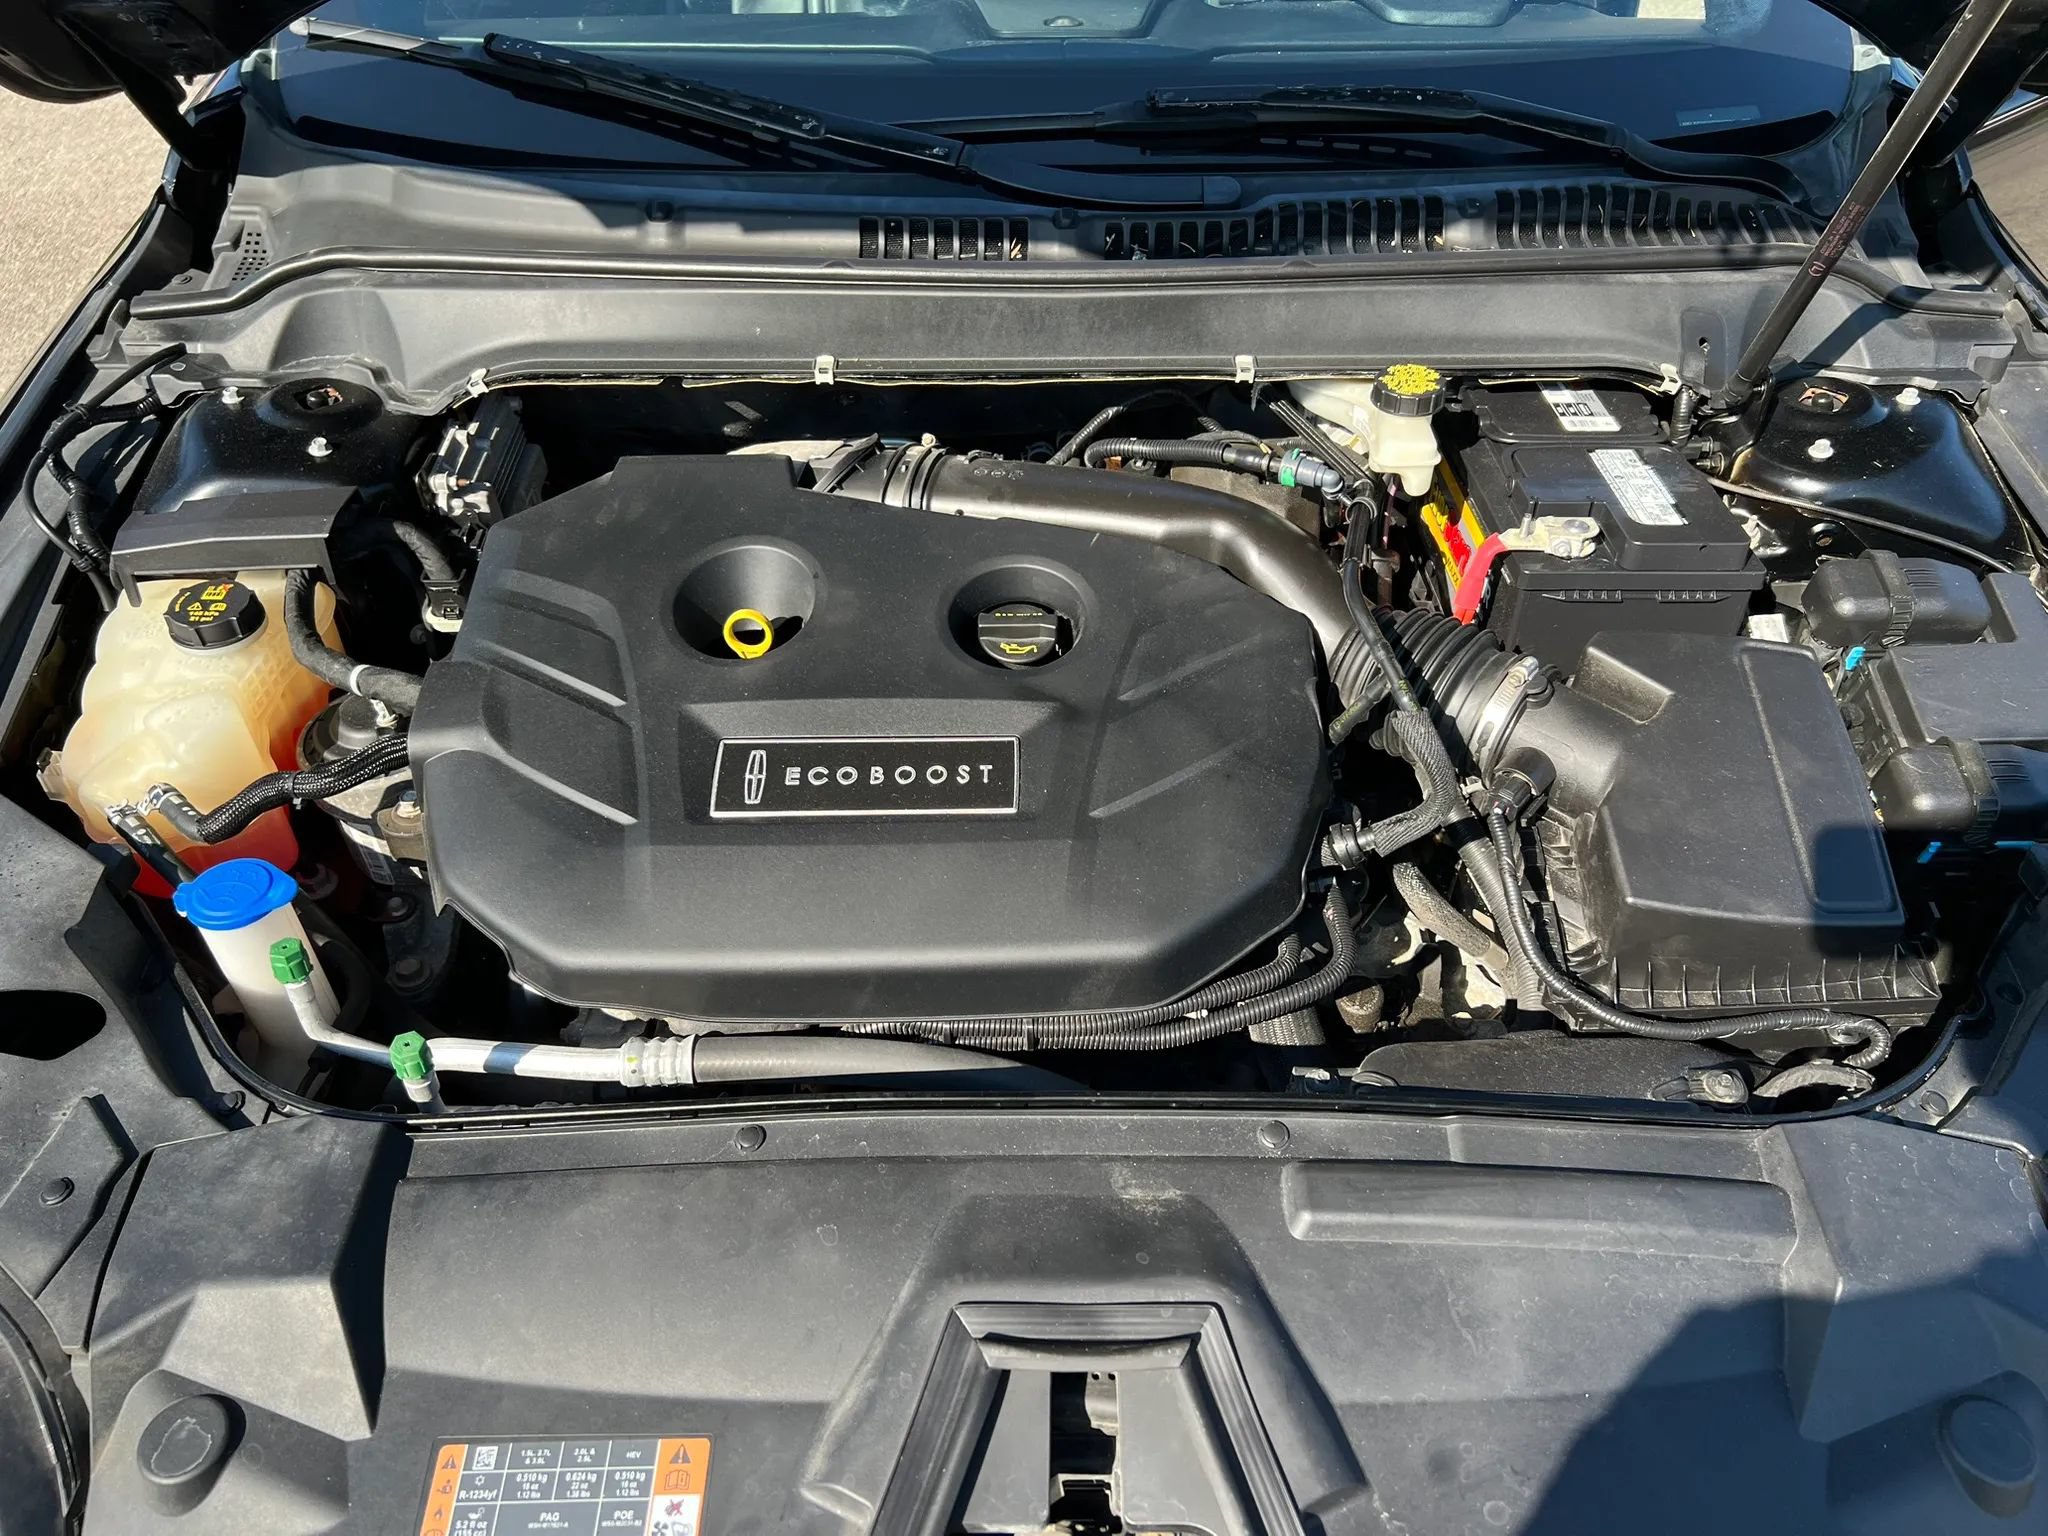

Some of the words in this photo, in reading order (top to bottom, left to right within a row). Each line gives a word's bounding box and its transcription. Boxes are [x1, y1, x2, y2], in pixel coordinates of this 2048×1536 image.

[785, 764, 993, 786] ECOBOOST
[516, 1472, 537, 1482] 0.510
[538, 1472, 549, 1484] kg
[587, 1471, 598, 1483] kg
[614, 1470, 635, 1481] 0.510
[636, 1470, 646, 1482] kg
[459, 1488, 498, 1500] R-1234yf
[540, 1511, 560, 1521] PAG
[613, 1509, 635, 1520] POE
[455, 1520, 469, 1529] 5.2
[476, 1520, 488, 1529] oz
